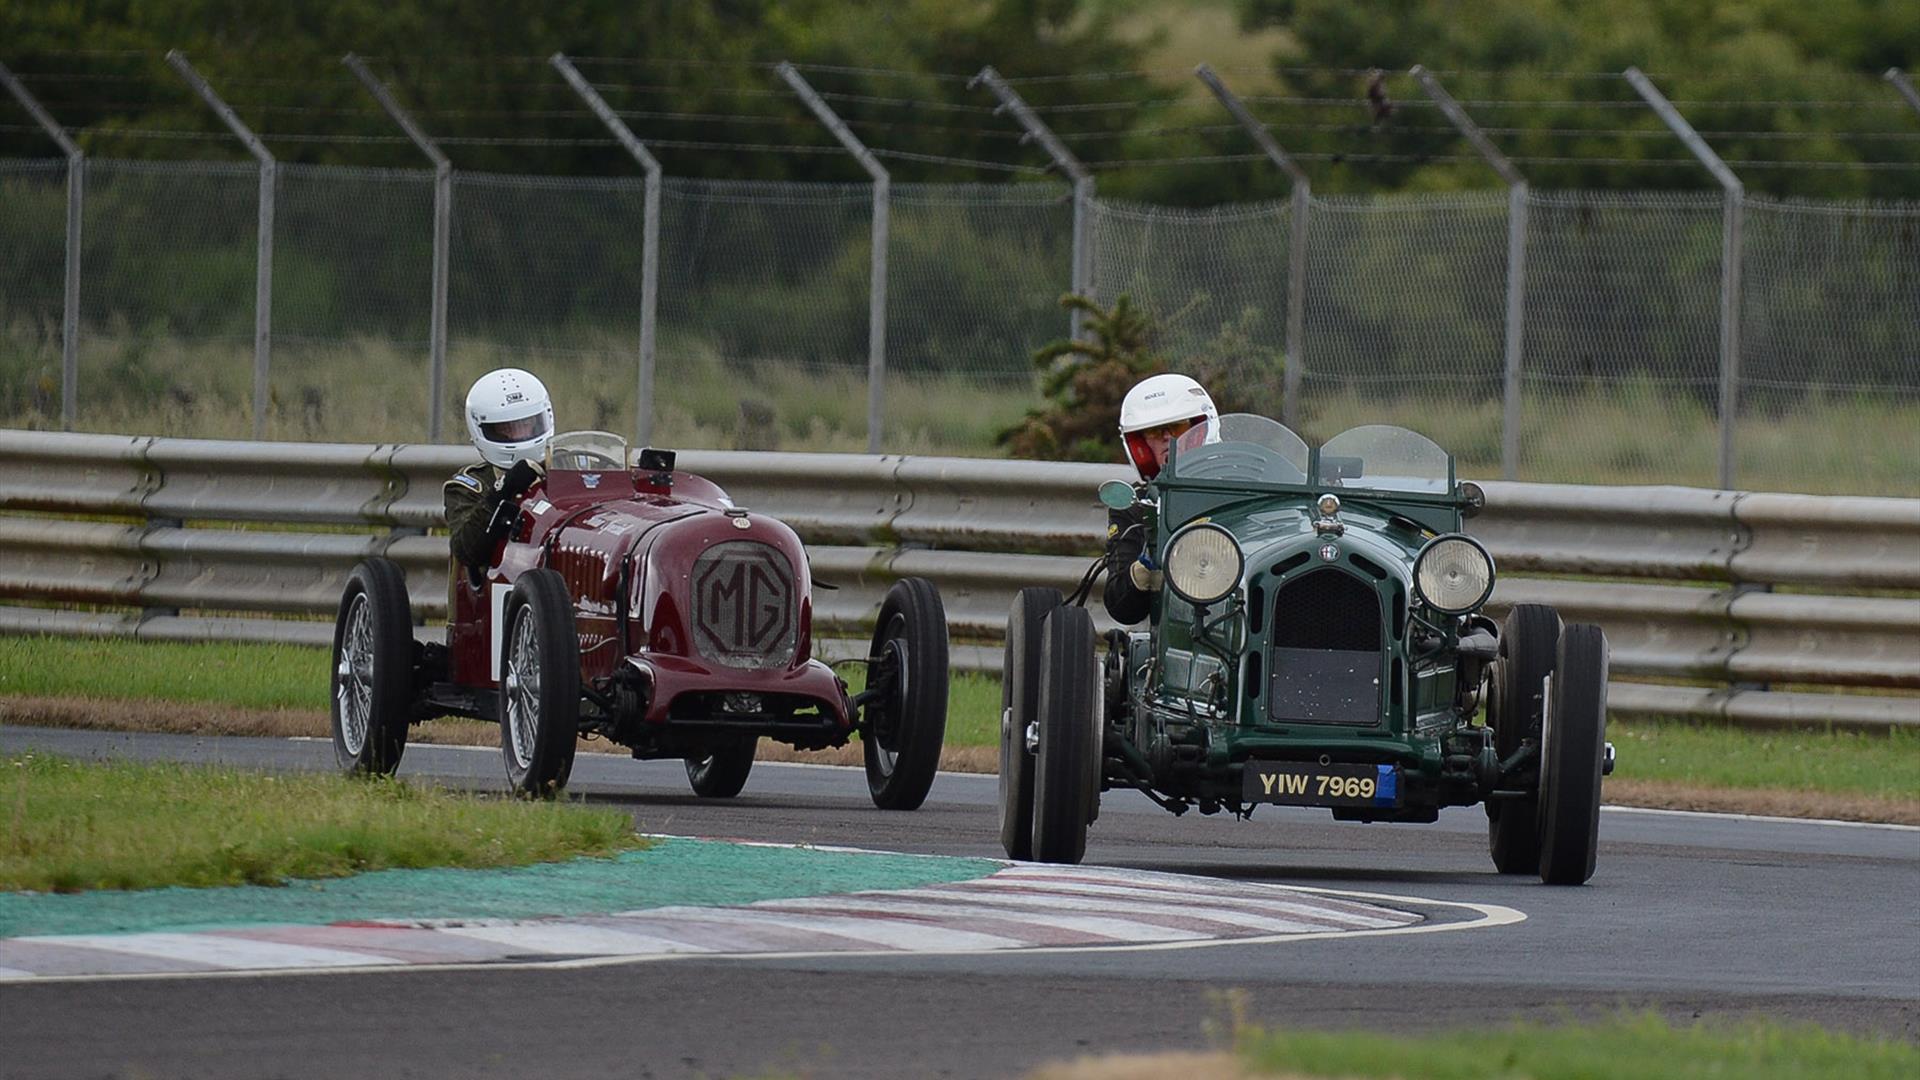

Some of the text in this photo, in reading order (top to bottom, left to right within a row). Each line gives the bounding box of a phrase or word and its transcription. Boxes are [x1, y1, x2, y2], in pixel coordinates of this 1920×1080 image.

[710, 562, 780, 647] MG
[1259, 773, 1375, 798] YIW 7969
